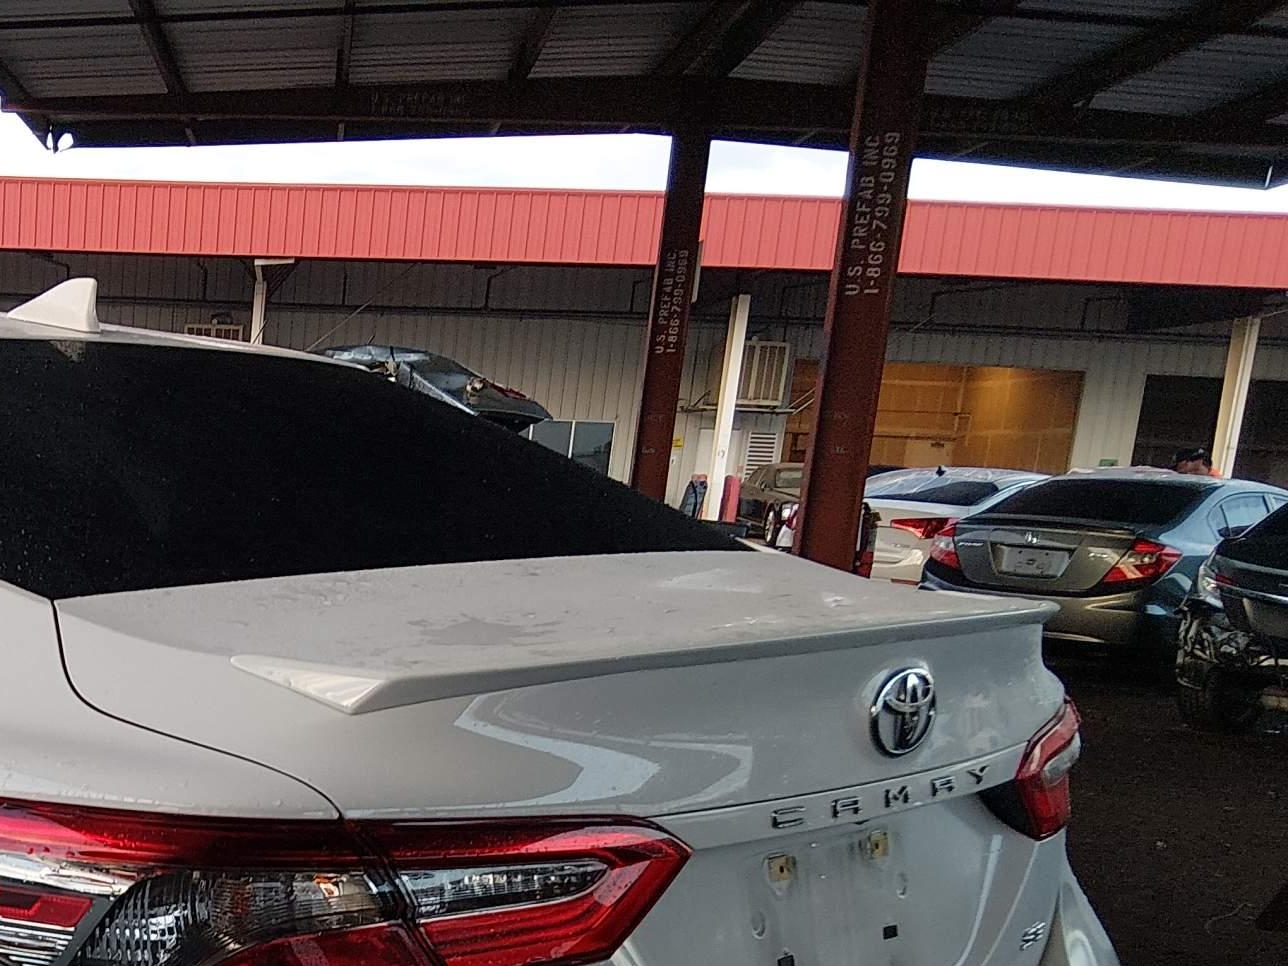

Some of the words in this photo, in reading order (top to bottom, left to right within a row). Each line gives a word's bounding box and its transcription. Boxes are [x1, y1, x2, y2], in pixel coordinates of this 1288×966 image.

[851, 174, 876, 249] PREFAB
[863, 131, 901, 295] 1-866-799-0969
[658, 278, 674, 325] PREFAB
[666, 249, 690, 353] 1-866-799-0969
[845, 260, 863, 296] U.S.
[654, 330, 668, 354] U.S.
[770, 764, 991, 830] CAMRY
